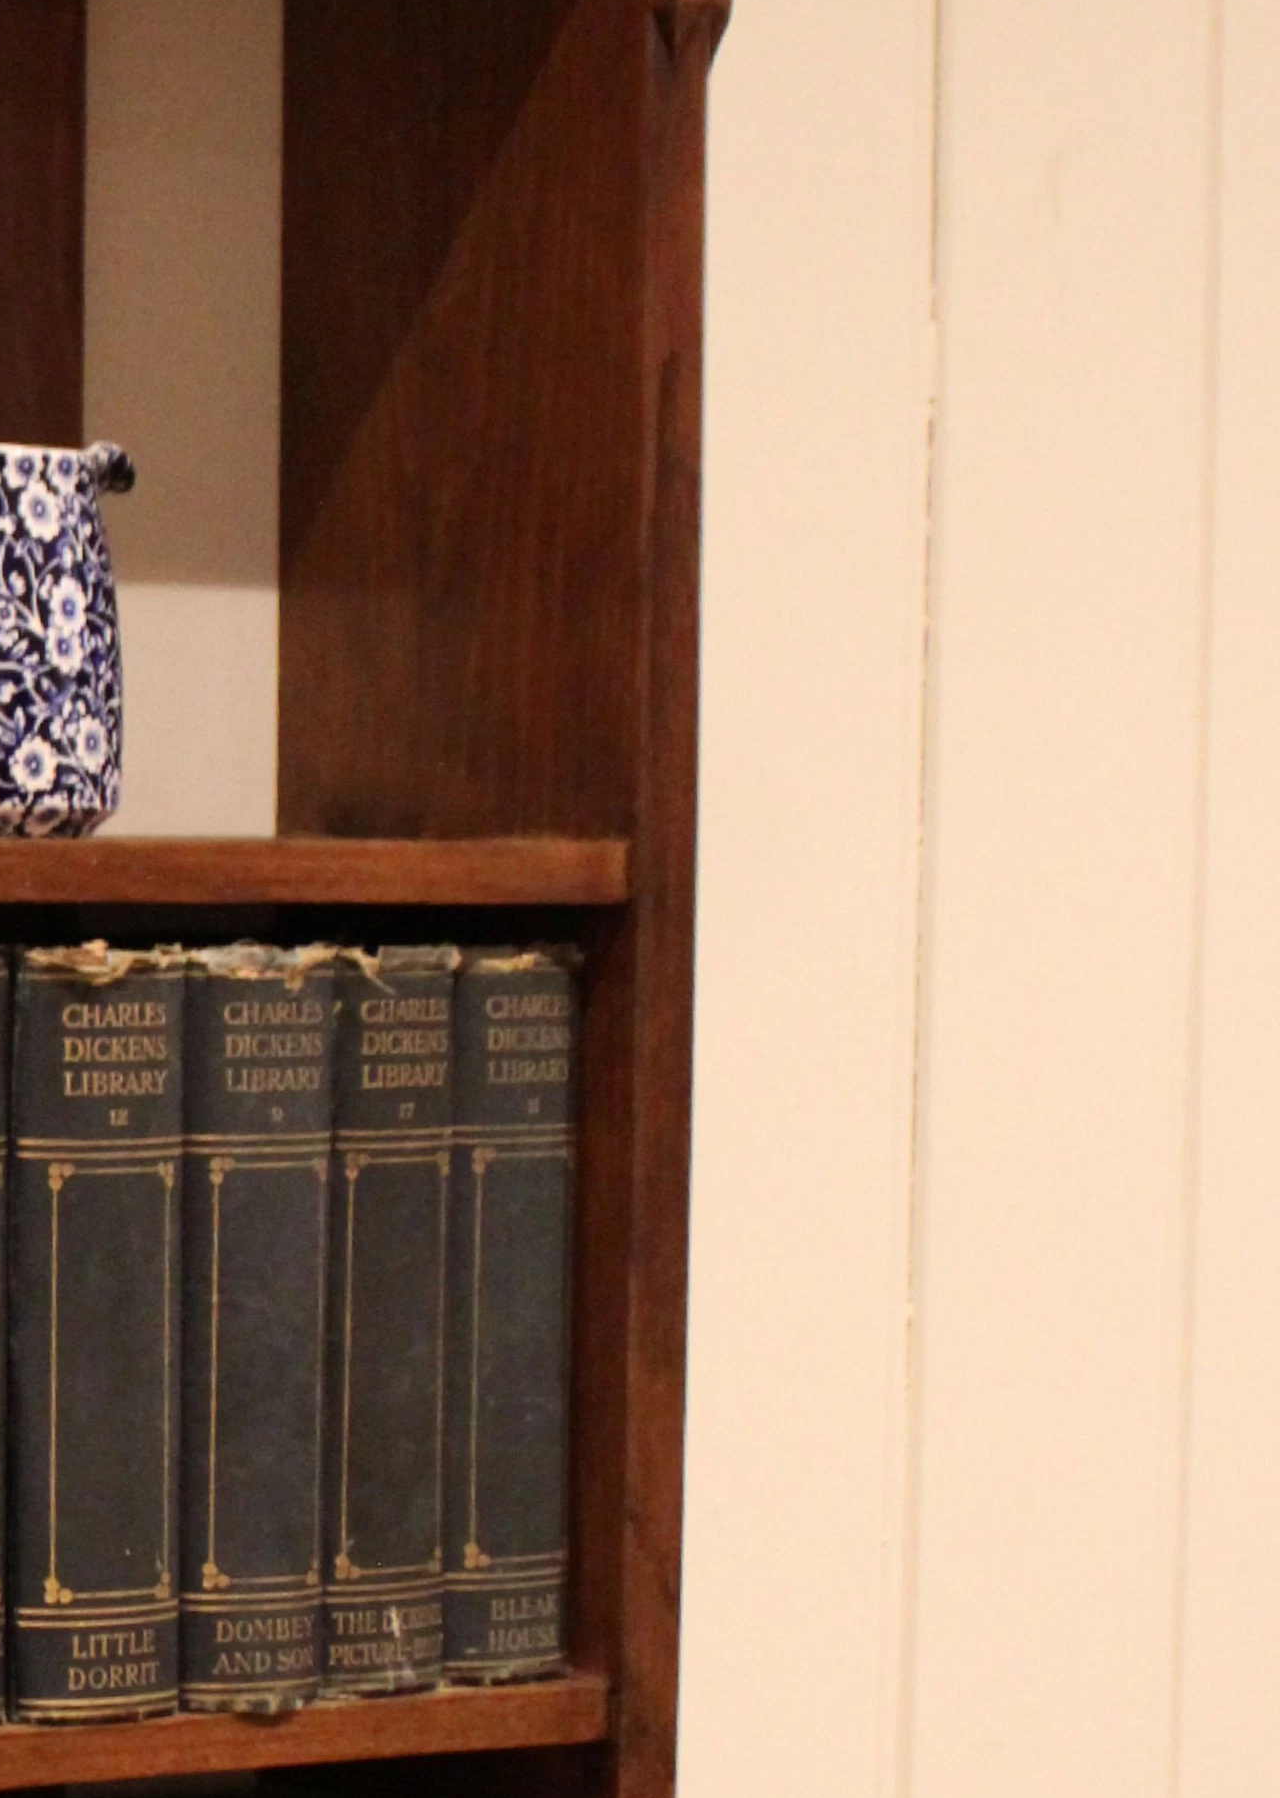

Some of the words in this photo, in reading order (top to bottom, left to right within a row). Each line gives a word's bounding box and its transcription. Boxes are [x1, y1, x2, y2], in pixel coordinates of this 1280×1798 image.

[61, 1001, 166, 1029] CHARLES
[224, 1002, 323, 1027] CHARLES
[360, 999, 449, 1024] CHARLES
[486, 995, 569, 1020] CHARLES
[62, 1034, 167, 1062] DICKENS
[225, 1031, 323, 1059] DICKENS
[360, 1029, 448, 1056] DICKENS
[487, 1025, 569, 1052] DICKENS
[63, 1068, 169, 1097] LIBRARY
[226, 1065, 324, 1093] LIBRARY
[361, 1059, 449, 1091] LIBRARY
[488, 1058, 569, 1083] LIBRARY
[215, 1614, 316, 1644] DOMBEY
[330, 1609, 377, 1638] THE
[71, 1628, 156, 1660] LITTLE
[489, 1624, 559, 1653] HOUSE
[211, 1652, 272, 1676] AND
[275, 1645, 315, 1673] SON
[67, 1660, 160, 1692] DORRIT
